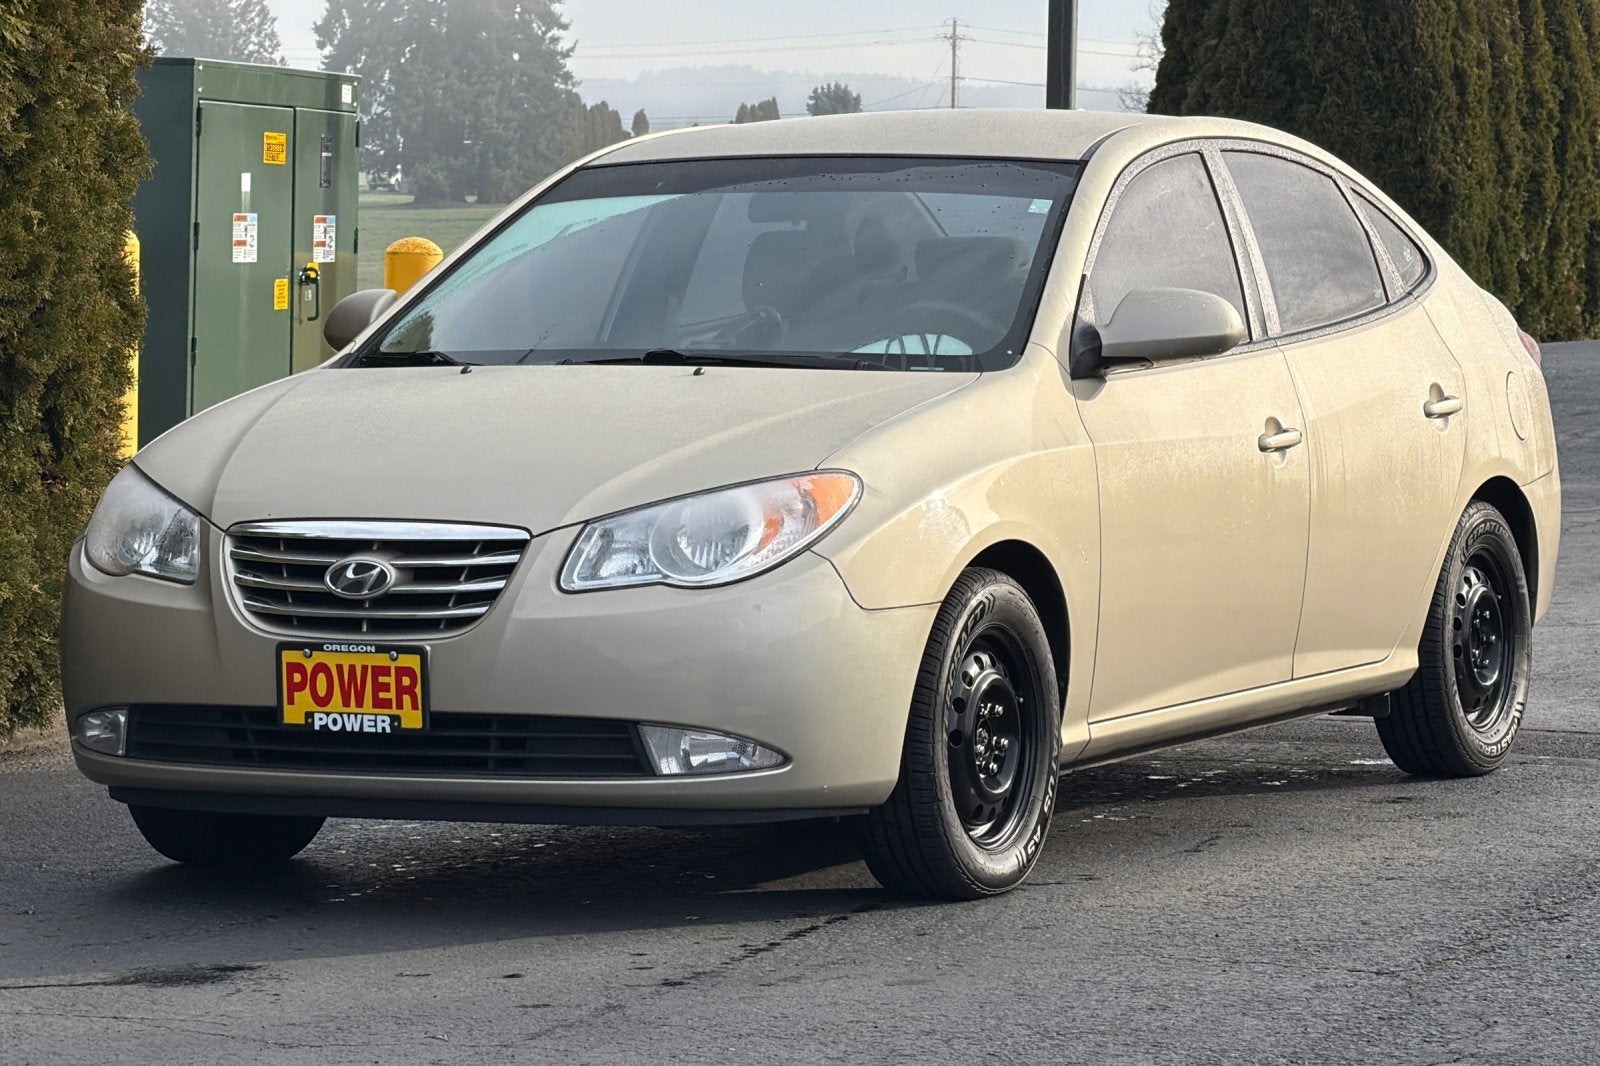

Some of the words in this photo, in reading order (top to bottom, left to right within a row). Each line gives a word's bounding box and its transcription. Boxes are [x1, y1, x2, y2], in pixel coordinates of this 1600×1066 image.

[323, 643, 376, 653] OREGON
[286, 661, 420, 711] POWER
[313, 712, 391, 734] POWER
